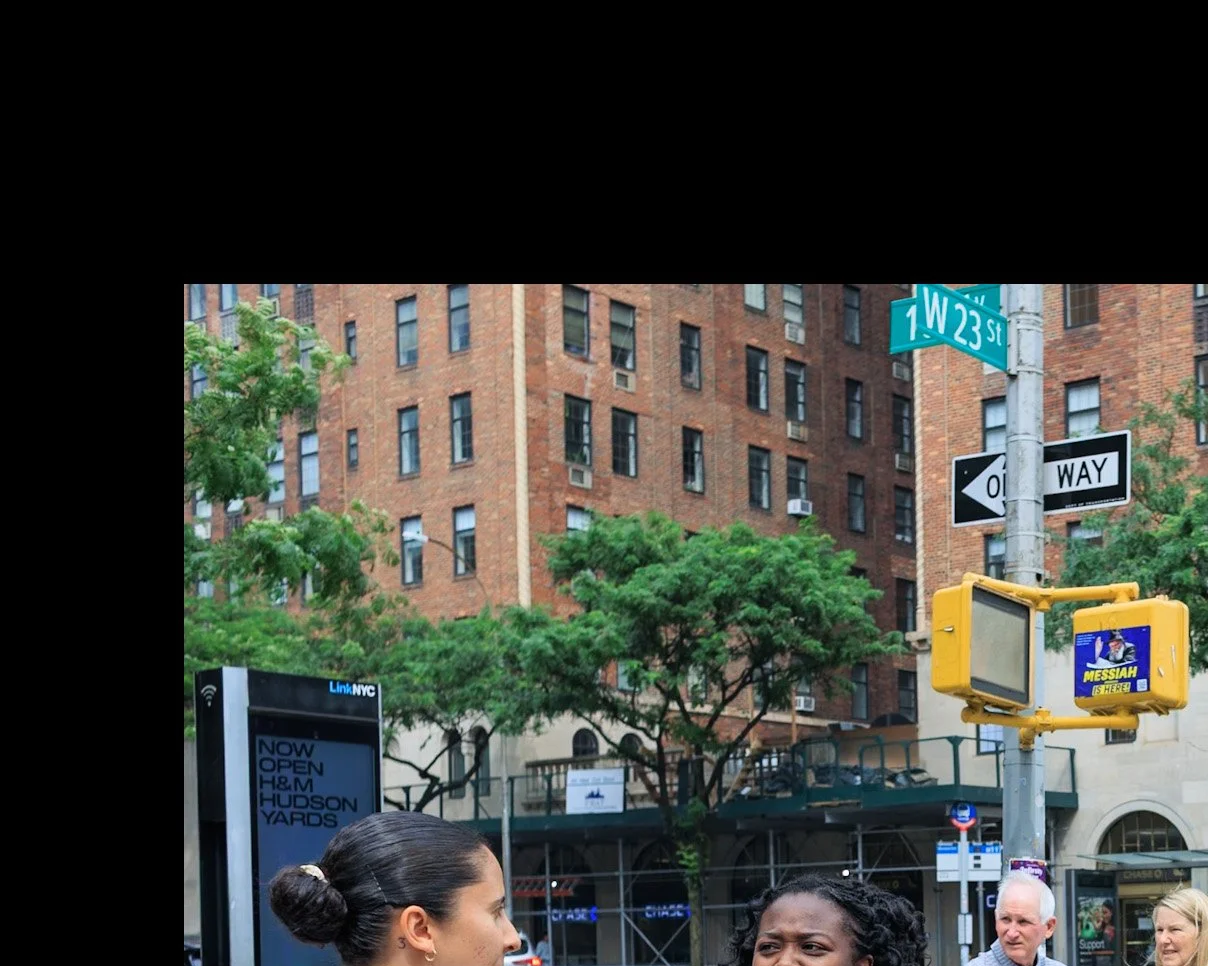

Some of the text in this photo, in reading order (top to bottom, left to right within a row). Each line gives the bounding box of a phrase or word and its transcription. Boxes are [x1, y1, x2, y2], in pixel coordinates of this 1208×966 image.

[923, 286, 1002, 351] W 23 St
[1056, 456, 1108, 489] WAY
[1083, 665, 1138, 683] MESSIAH
[329, 680, 376, 697] LinkNYC
[1093, 682, 1130, 694] IS HERE!
[258, 738, 315, 758] NOW
[259, 757, 324, 776] OPEN
[259, 774, 313, 793] H&M
[259, 792, 358, 813] HUDSON
[261, 809, 338, 828] YARDS
[1079, 939, 1105, 951] Support
